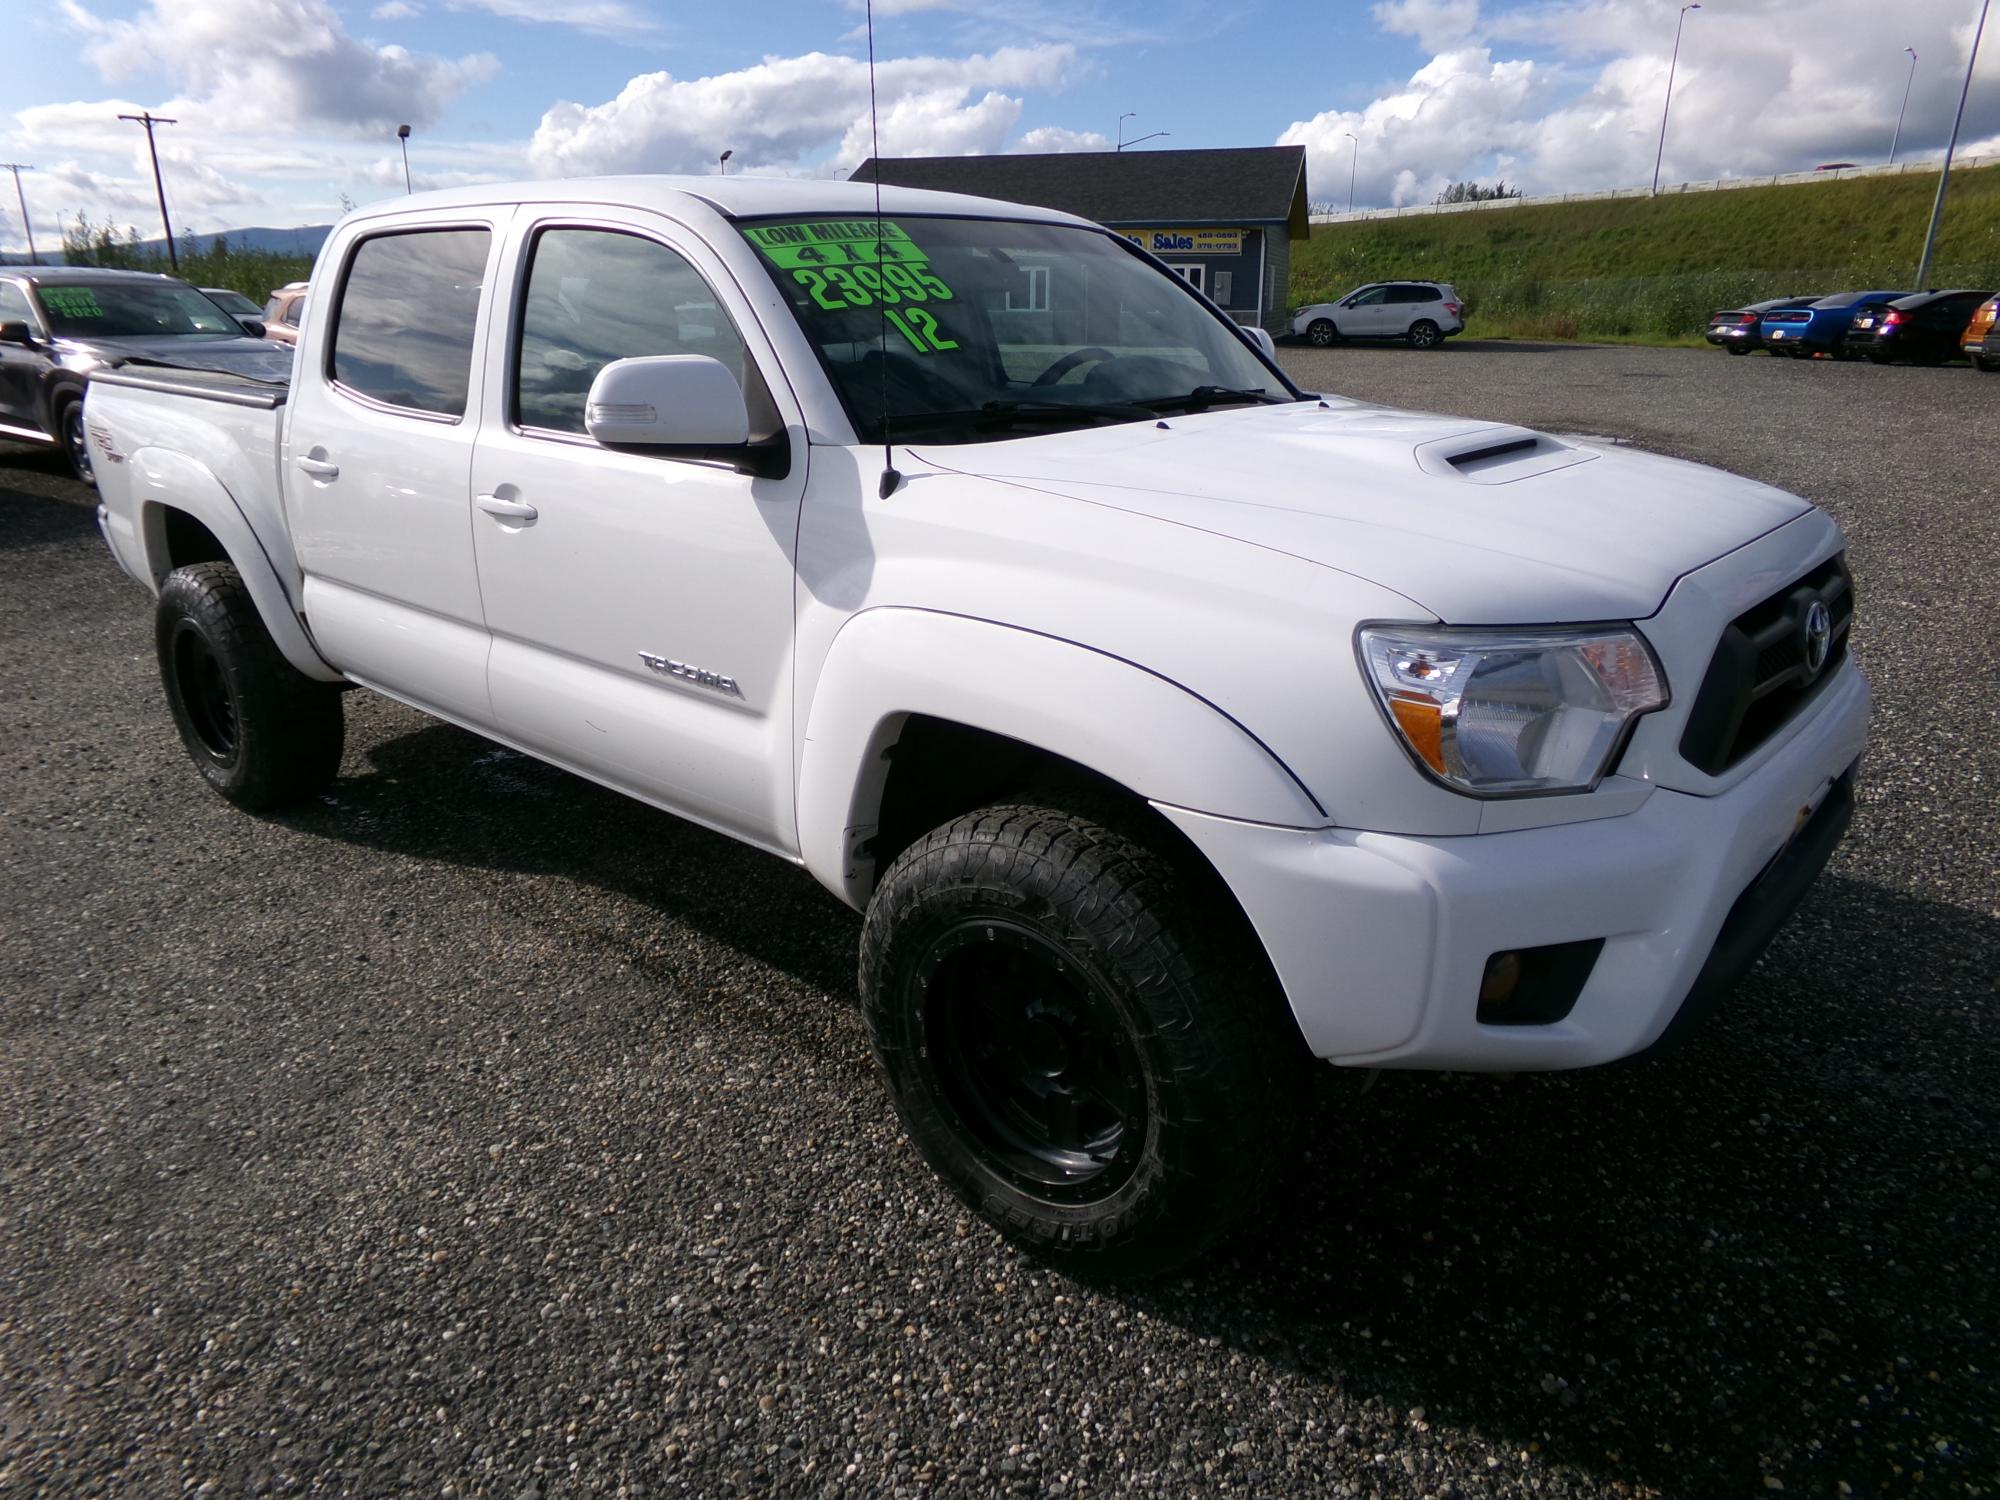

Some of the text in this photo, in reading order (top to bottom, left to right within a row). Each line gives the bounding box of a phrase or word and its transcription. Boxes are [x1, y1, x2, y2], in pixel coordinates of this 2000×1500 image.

[754, 222, 900, 246] LOW MILEAGE
[1154, 232, 1194, 250] Sales
[796, 246, 828, 264] 4
[873, 242, 904, 259] 4
[793, 262, 953, 310] 23995
[883, 307, 959, 352] 12
[638, 651, 743, 697] TACOMA
